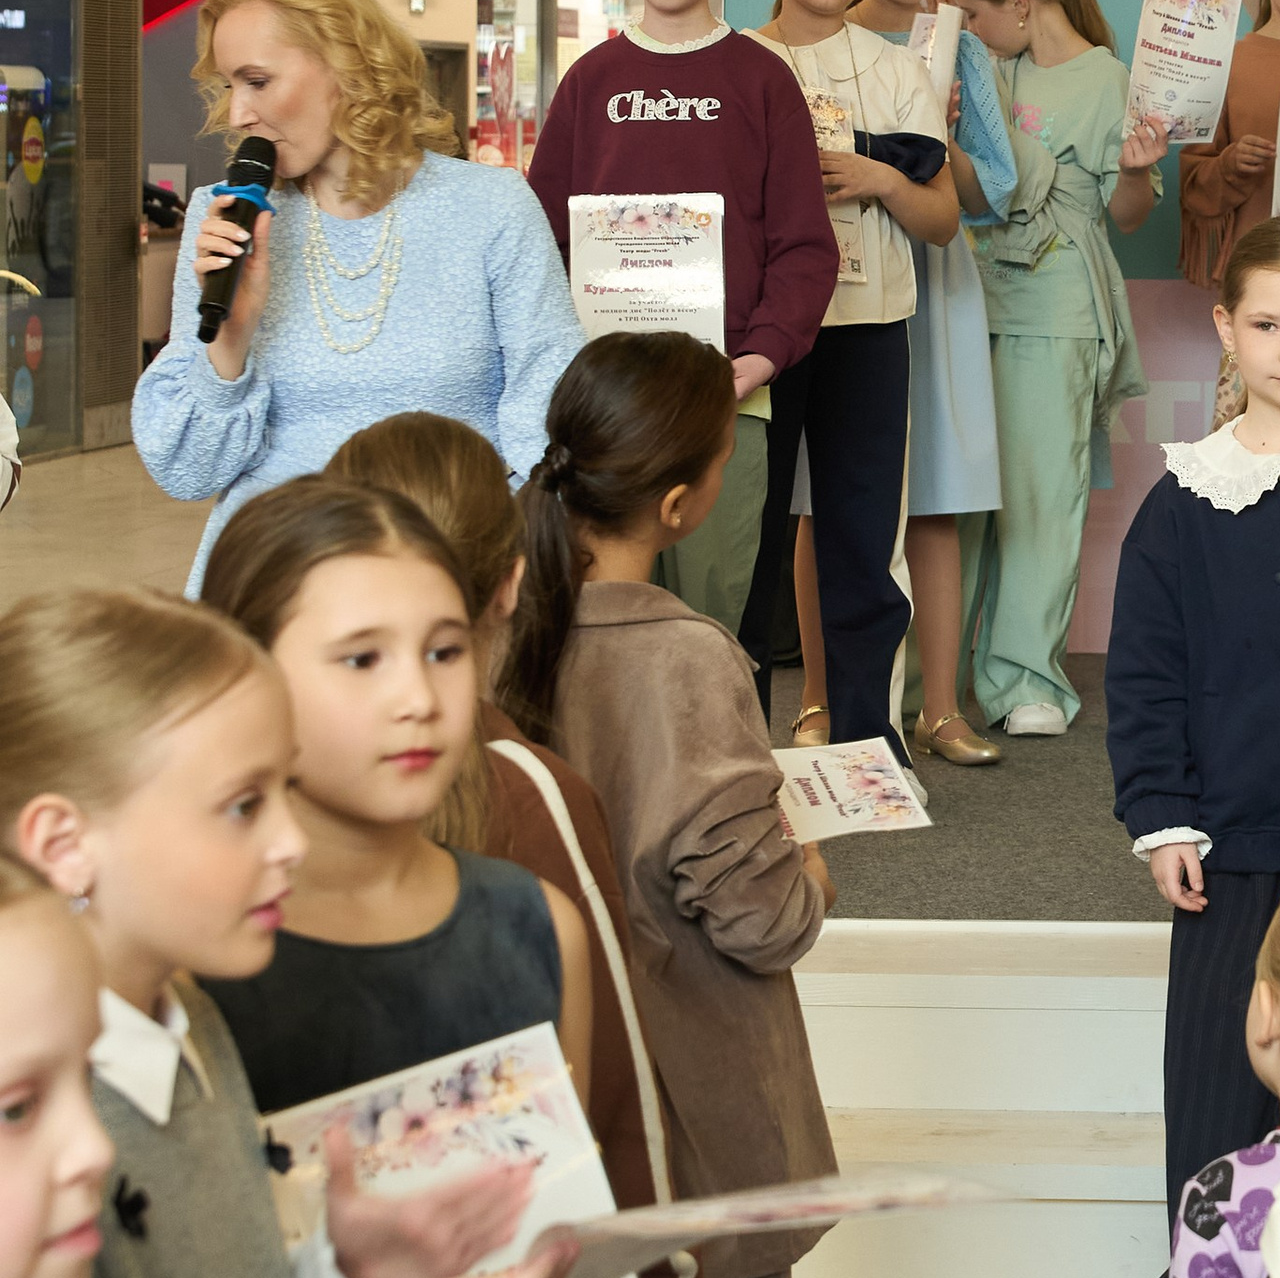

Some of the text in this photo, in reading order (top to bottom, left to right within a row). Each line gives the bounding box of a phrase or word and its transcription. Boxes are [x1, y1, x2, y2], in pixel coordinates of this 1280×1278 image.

[1161, 23, 1195, 39] Диплом
[606, 88, 722, 123] Chère
[620, 258, 673, 270] Диплом
[792, 777, 822, 807] Диплом
